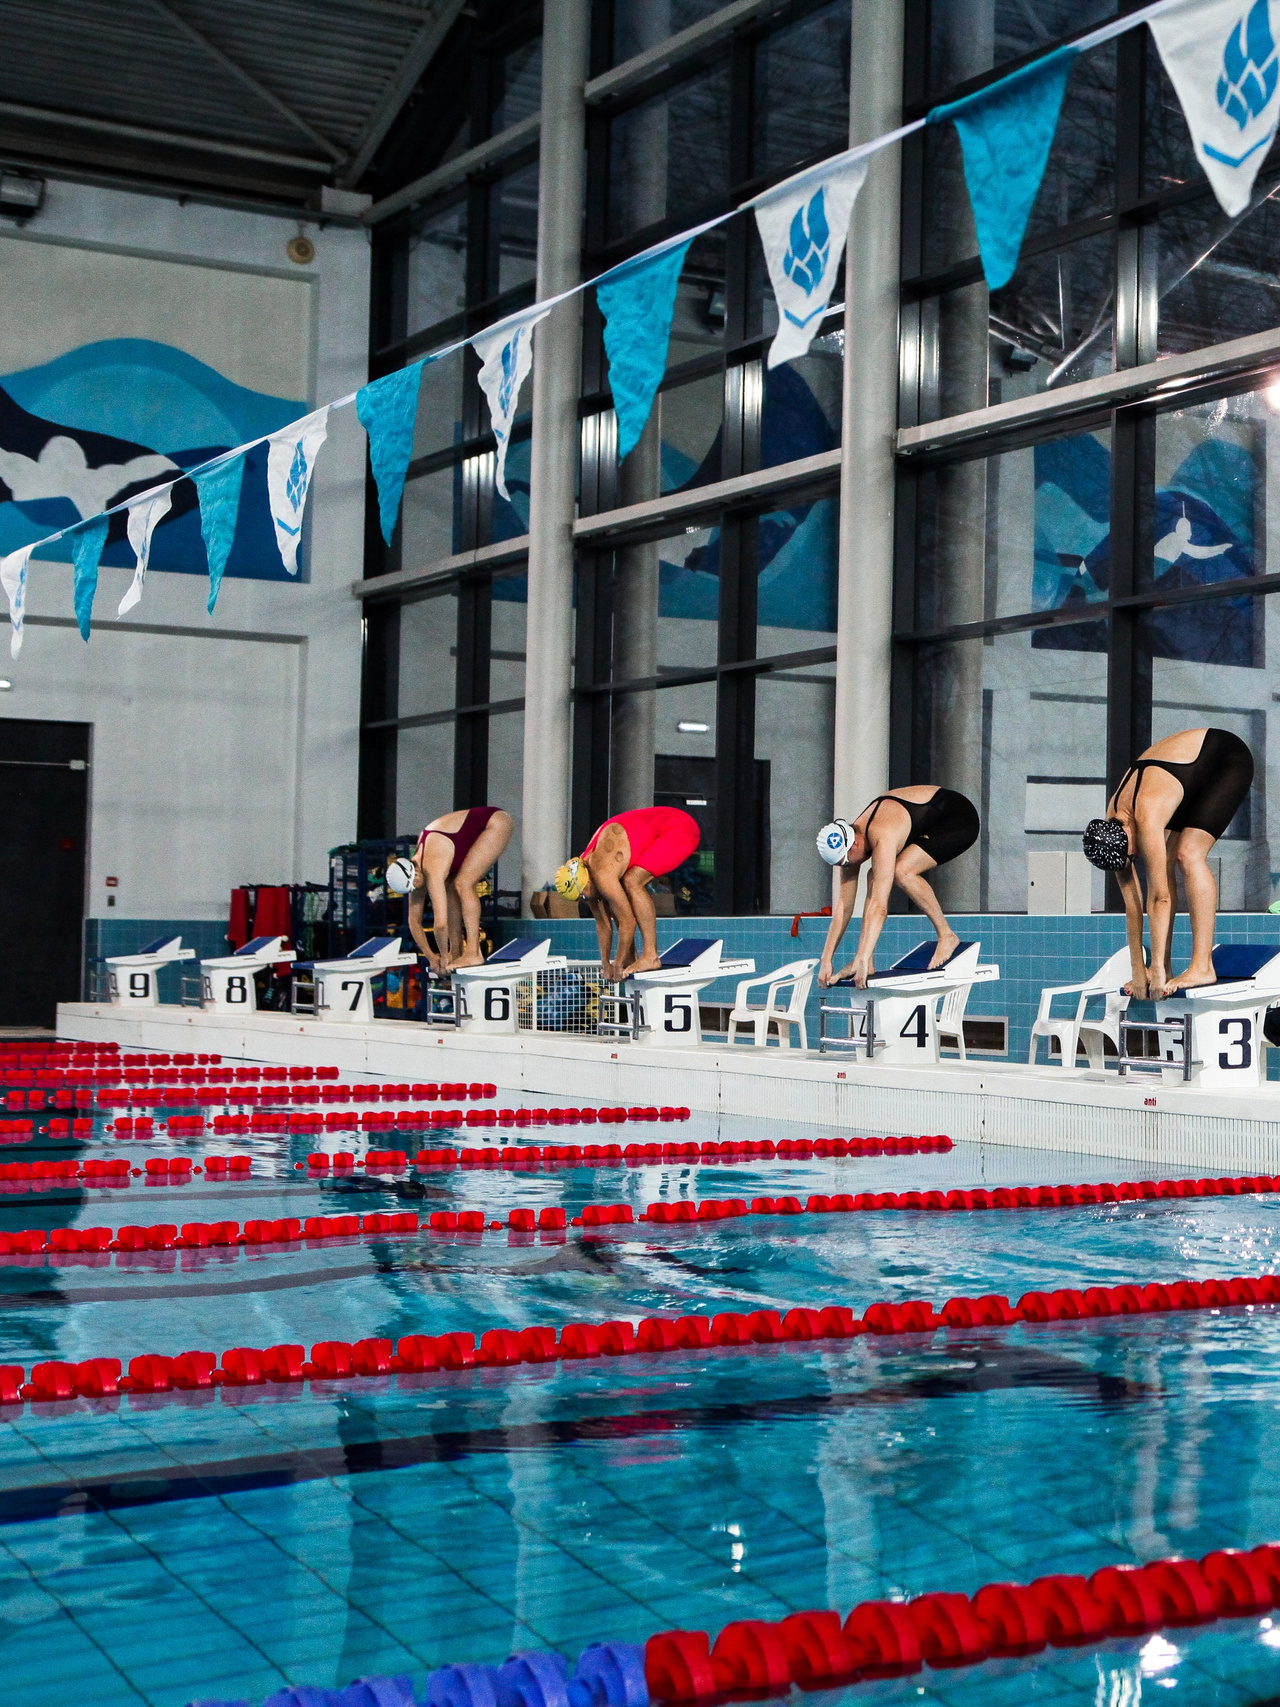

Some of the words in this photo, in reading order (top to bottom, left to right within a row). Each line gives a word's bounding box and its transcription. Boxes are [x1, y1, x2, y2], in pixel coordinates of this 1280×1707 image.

[130, 972, 150, 998] 9
[226, 976, 247, 1003] 8
[340, 980, 364, 1012] 7
[484, 987, 510, 1020] 6
[664, 994, 692, 1032] 5
[900, 1004, 930, 1048] 4
[1218, 1018, 1252, 1070] 3
[1144, 1097, 1156, 1106] anti
